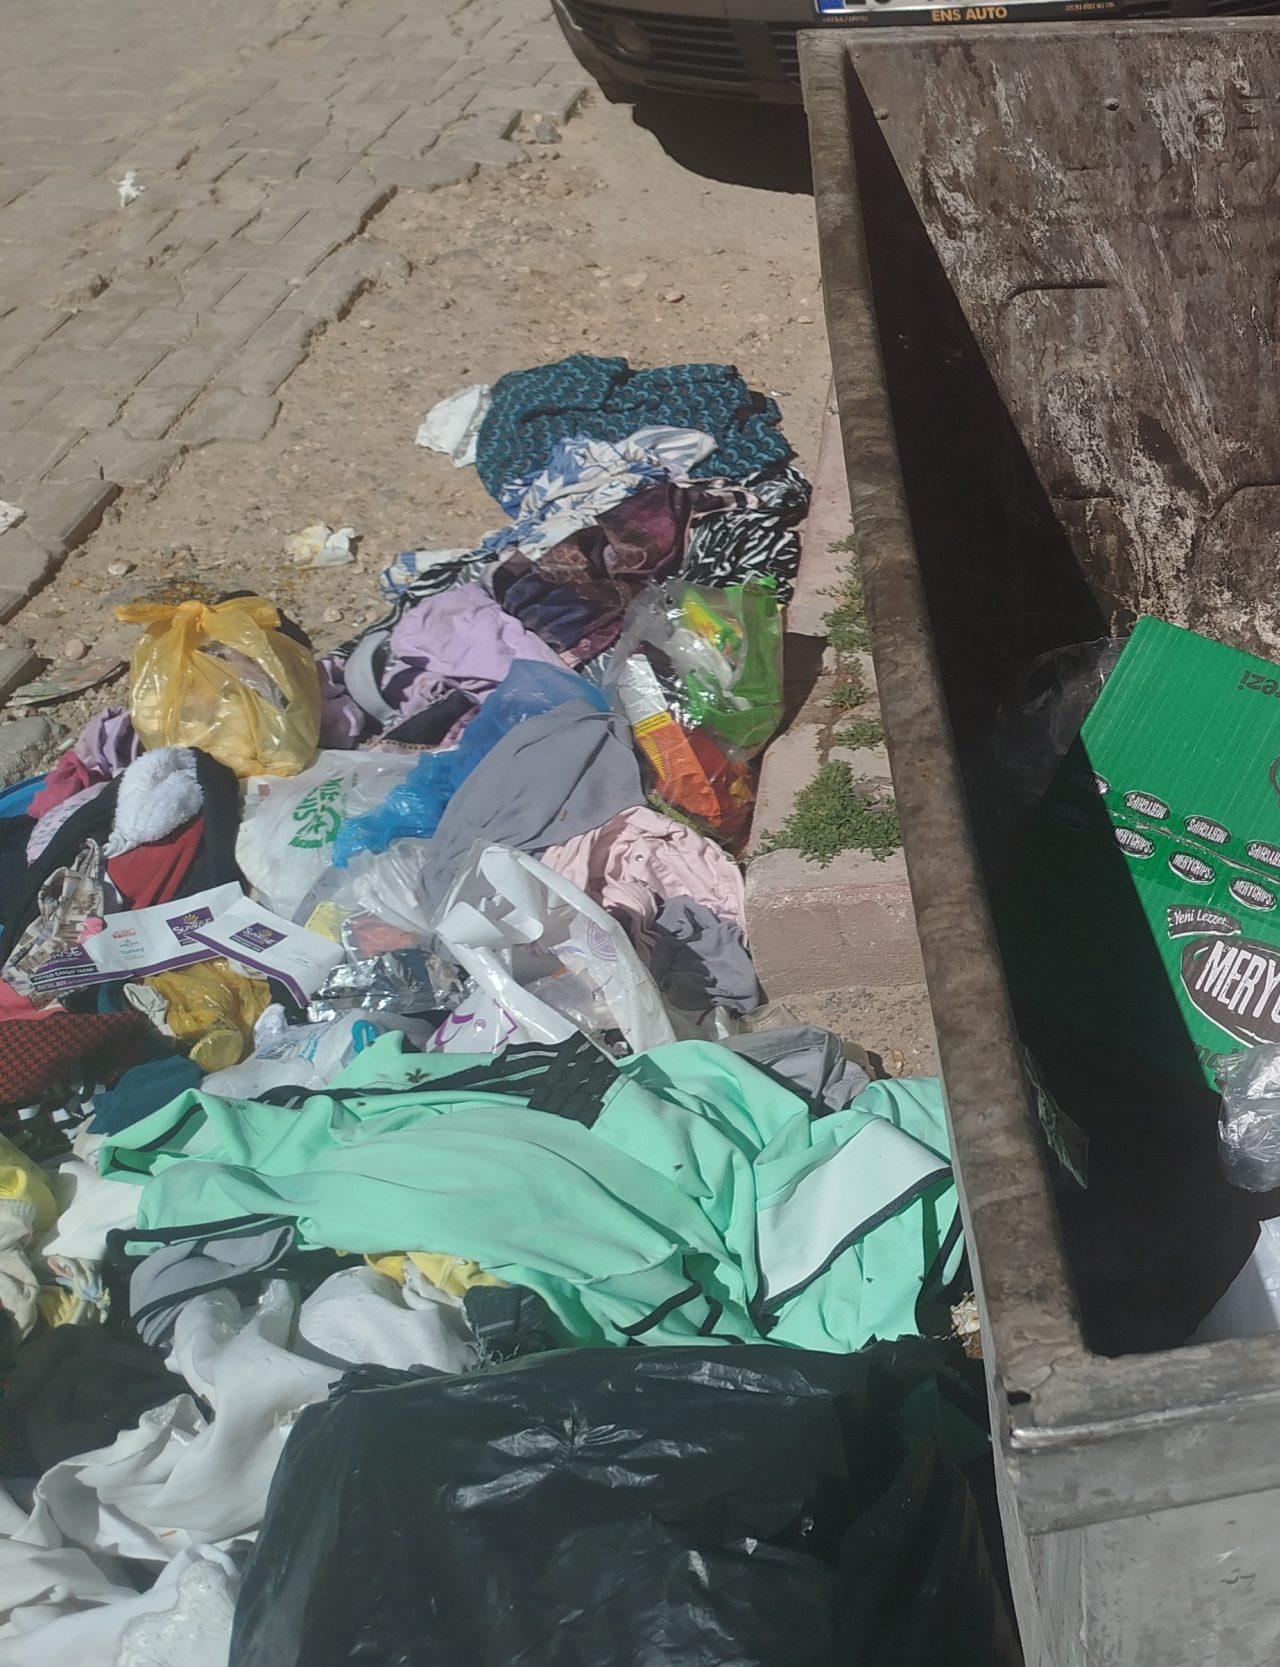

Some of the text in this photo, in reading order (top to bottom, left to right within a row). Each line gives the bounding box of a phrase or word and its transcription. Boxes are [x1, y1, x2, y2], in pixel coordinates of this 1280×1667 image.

[932, 6, 1007, 22] ENS AUTO
[1173, 909, 1194, 926] Yeni
